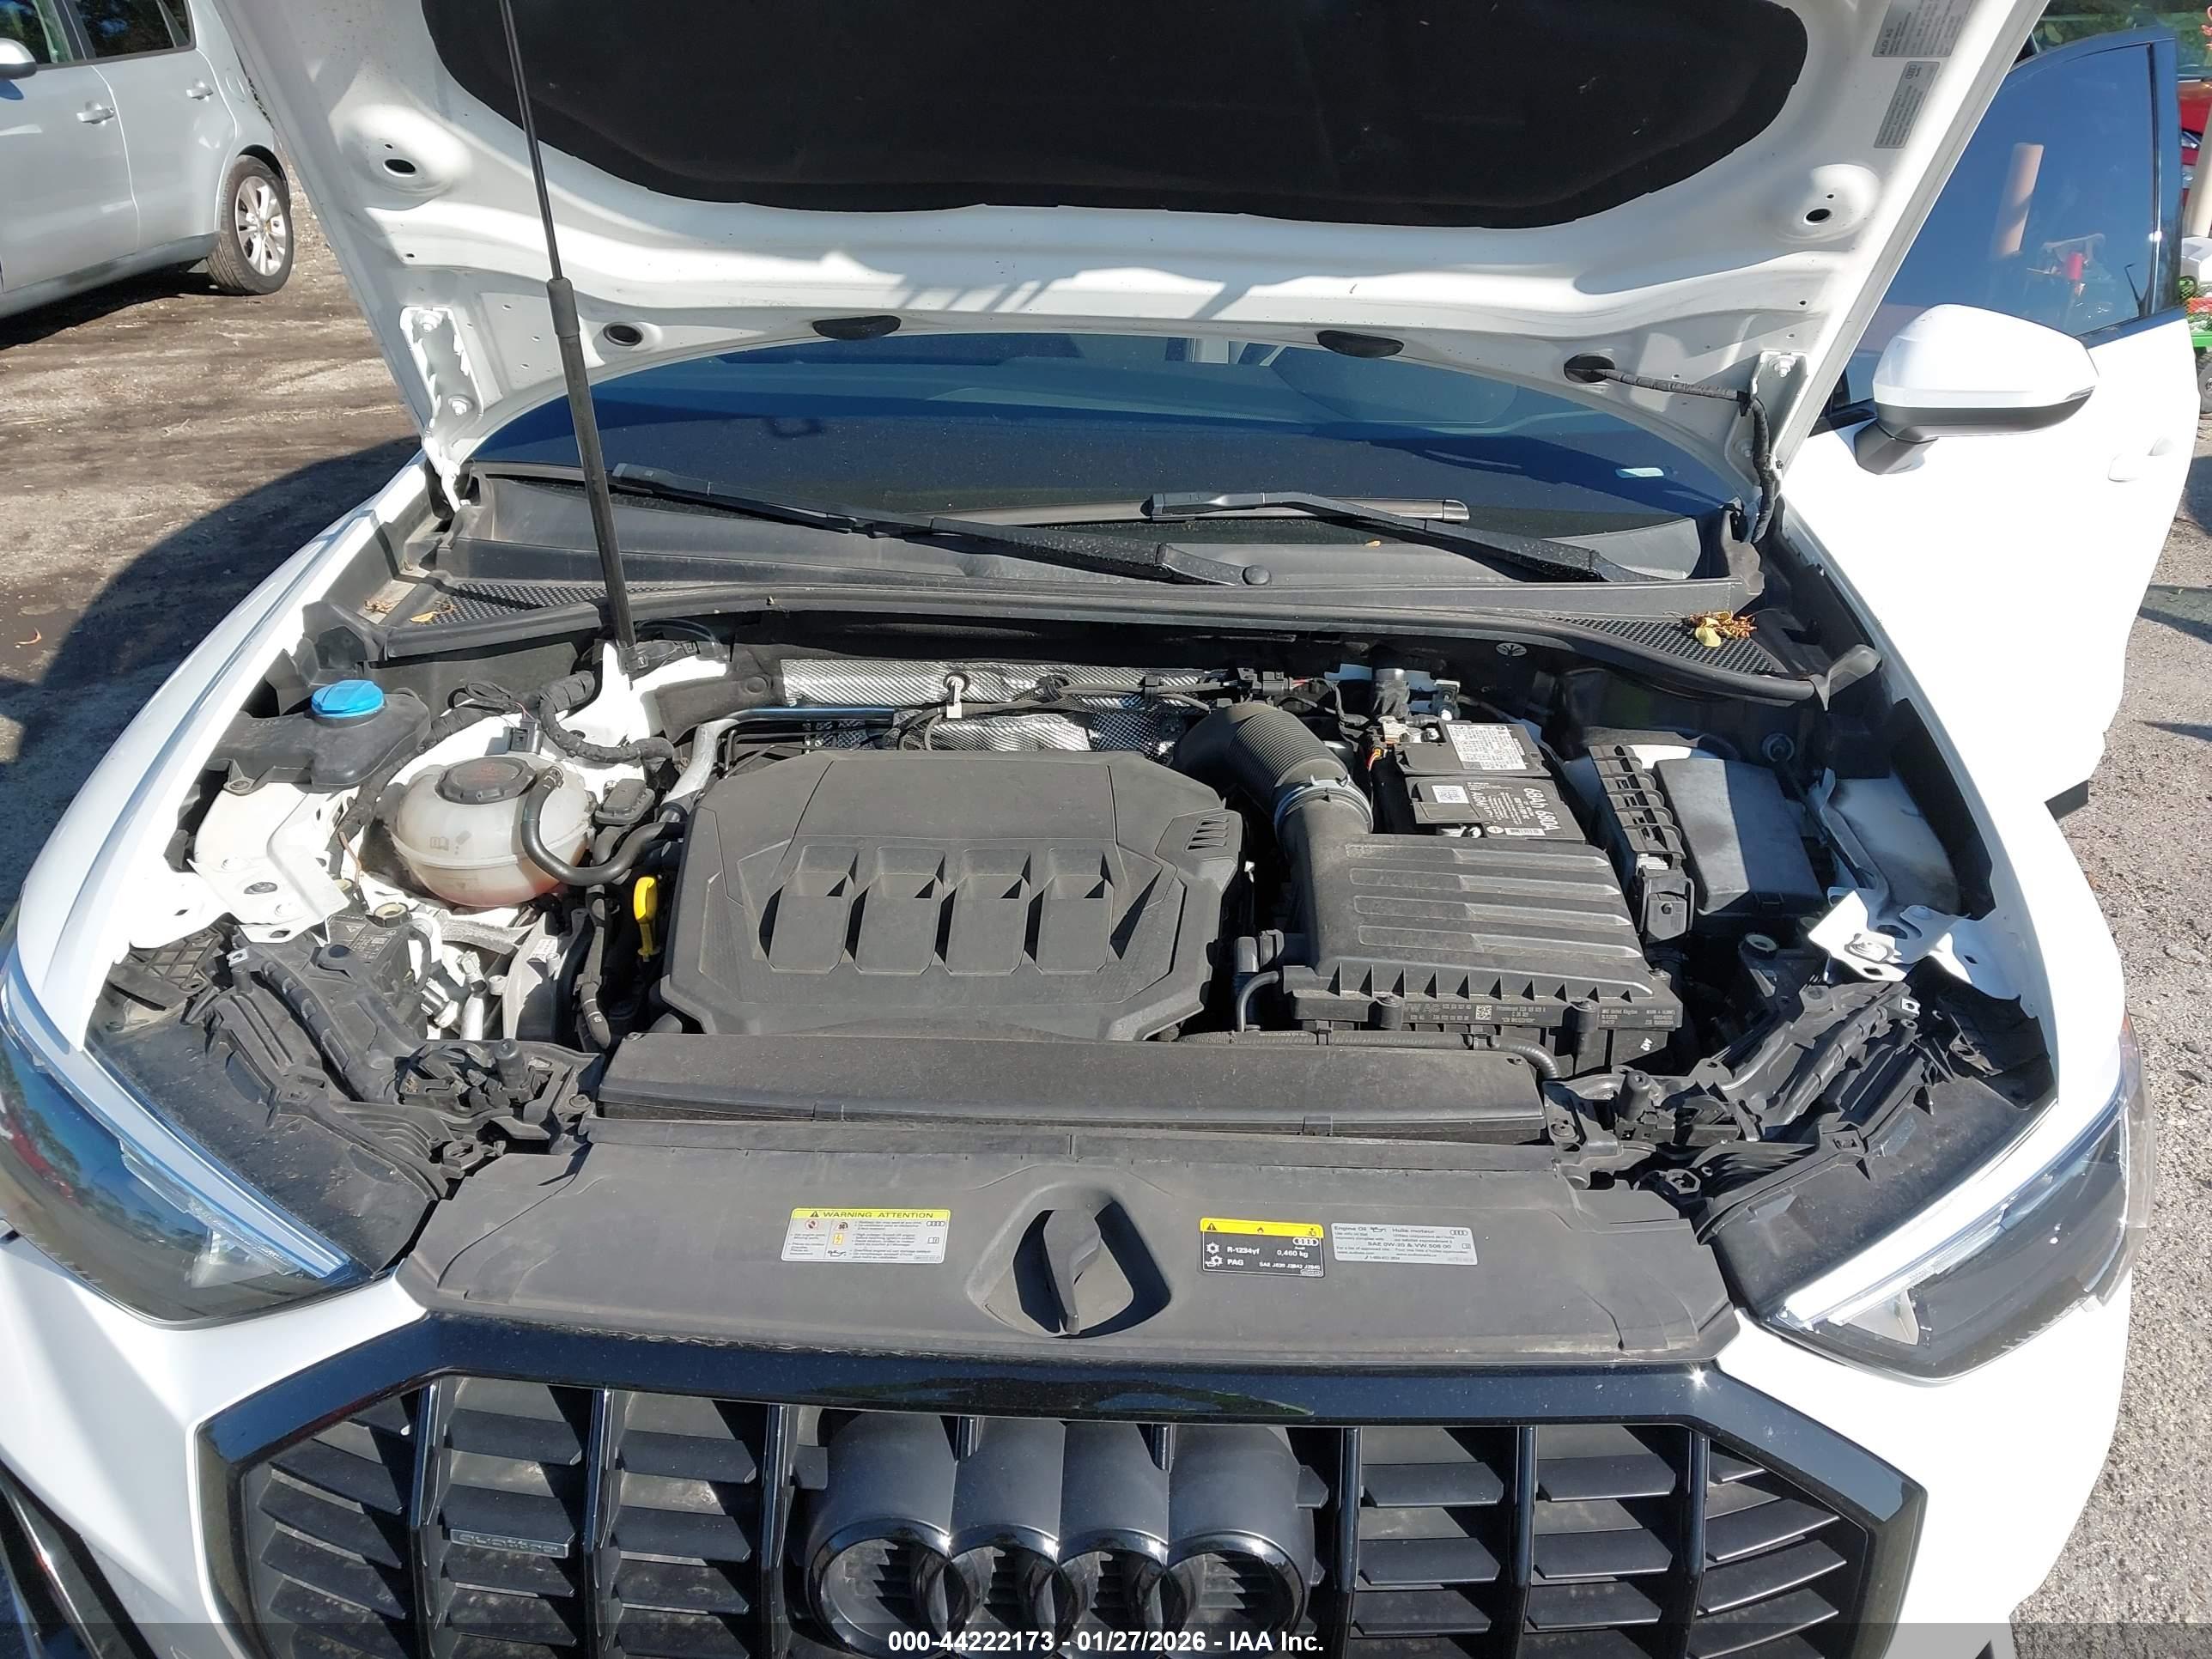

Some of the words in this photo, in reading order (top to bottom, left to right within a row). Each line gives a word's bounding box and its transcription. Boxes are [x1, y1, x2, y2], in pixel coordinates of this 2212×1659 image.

[1523, 787, 1549, 809] 68Ah
[1534, 810, 1561, 831] 680A
[878, 1211, 934, 1219] ATTENTION
[1227, 1246, 1260, 1255] R-1234yf
[1298, 1250, 1309, 1259] kg
[1227, 1258, 1244, 1267] PAG
